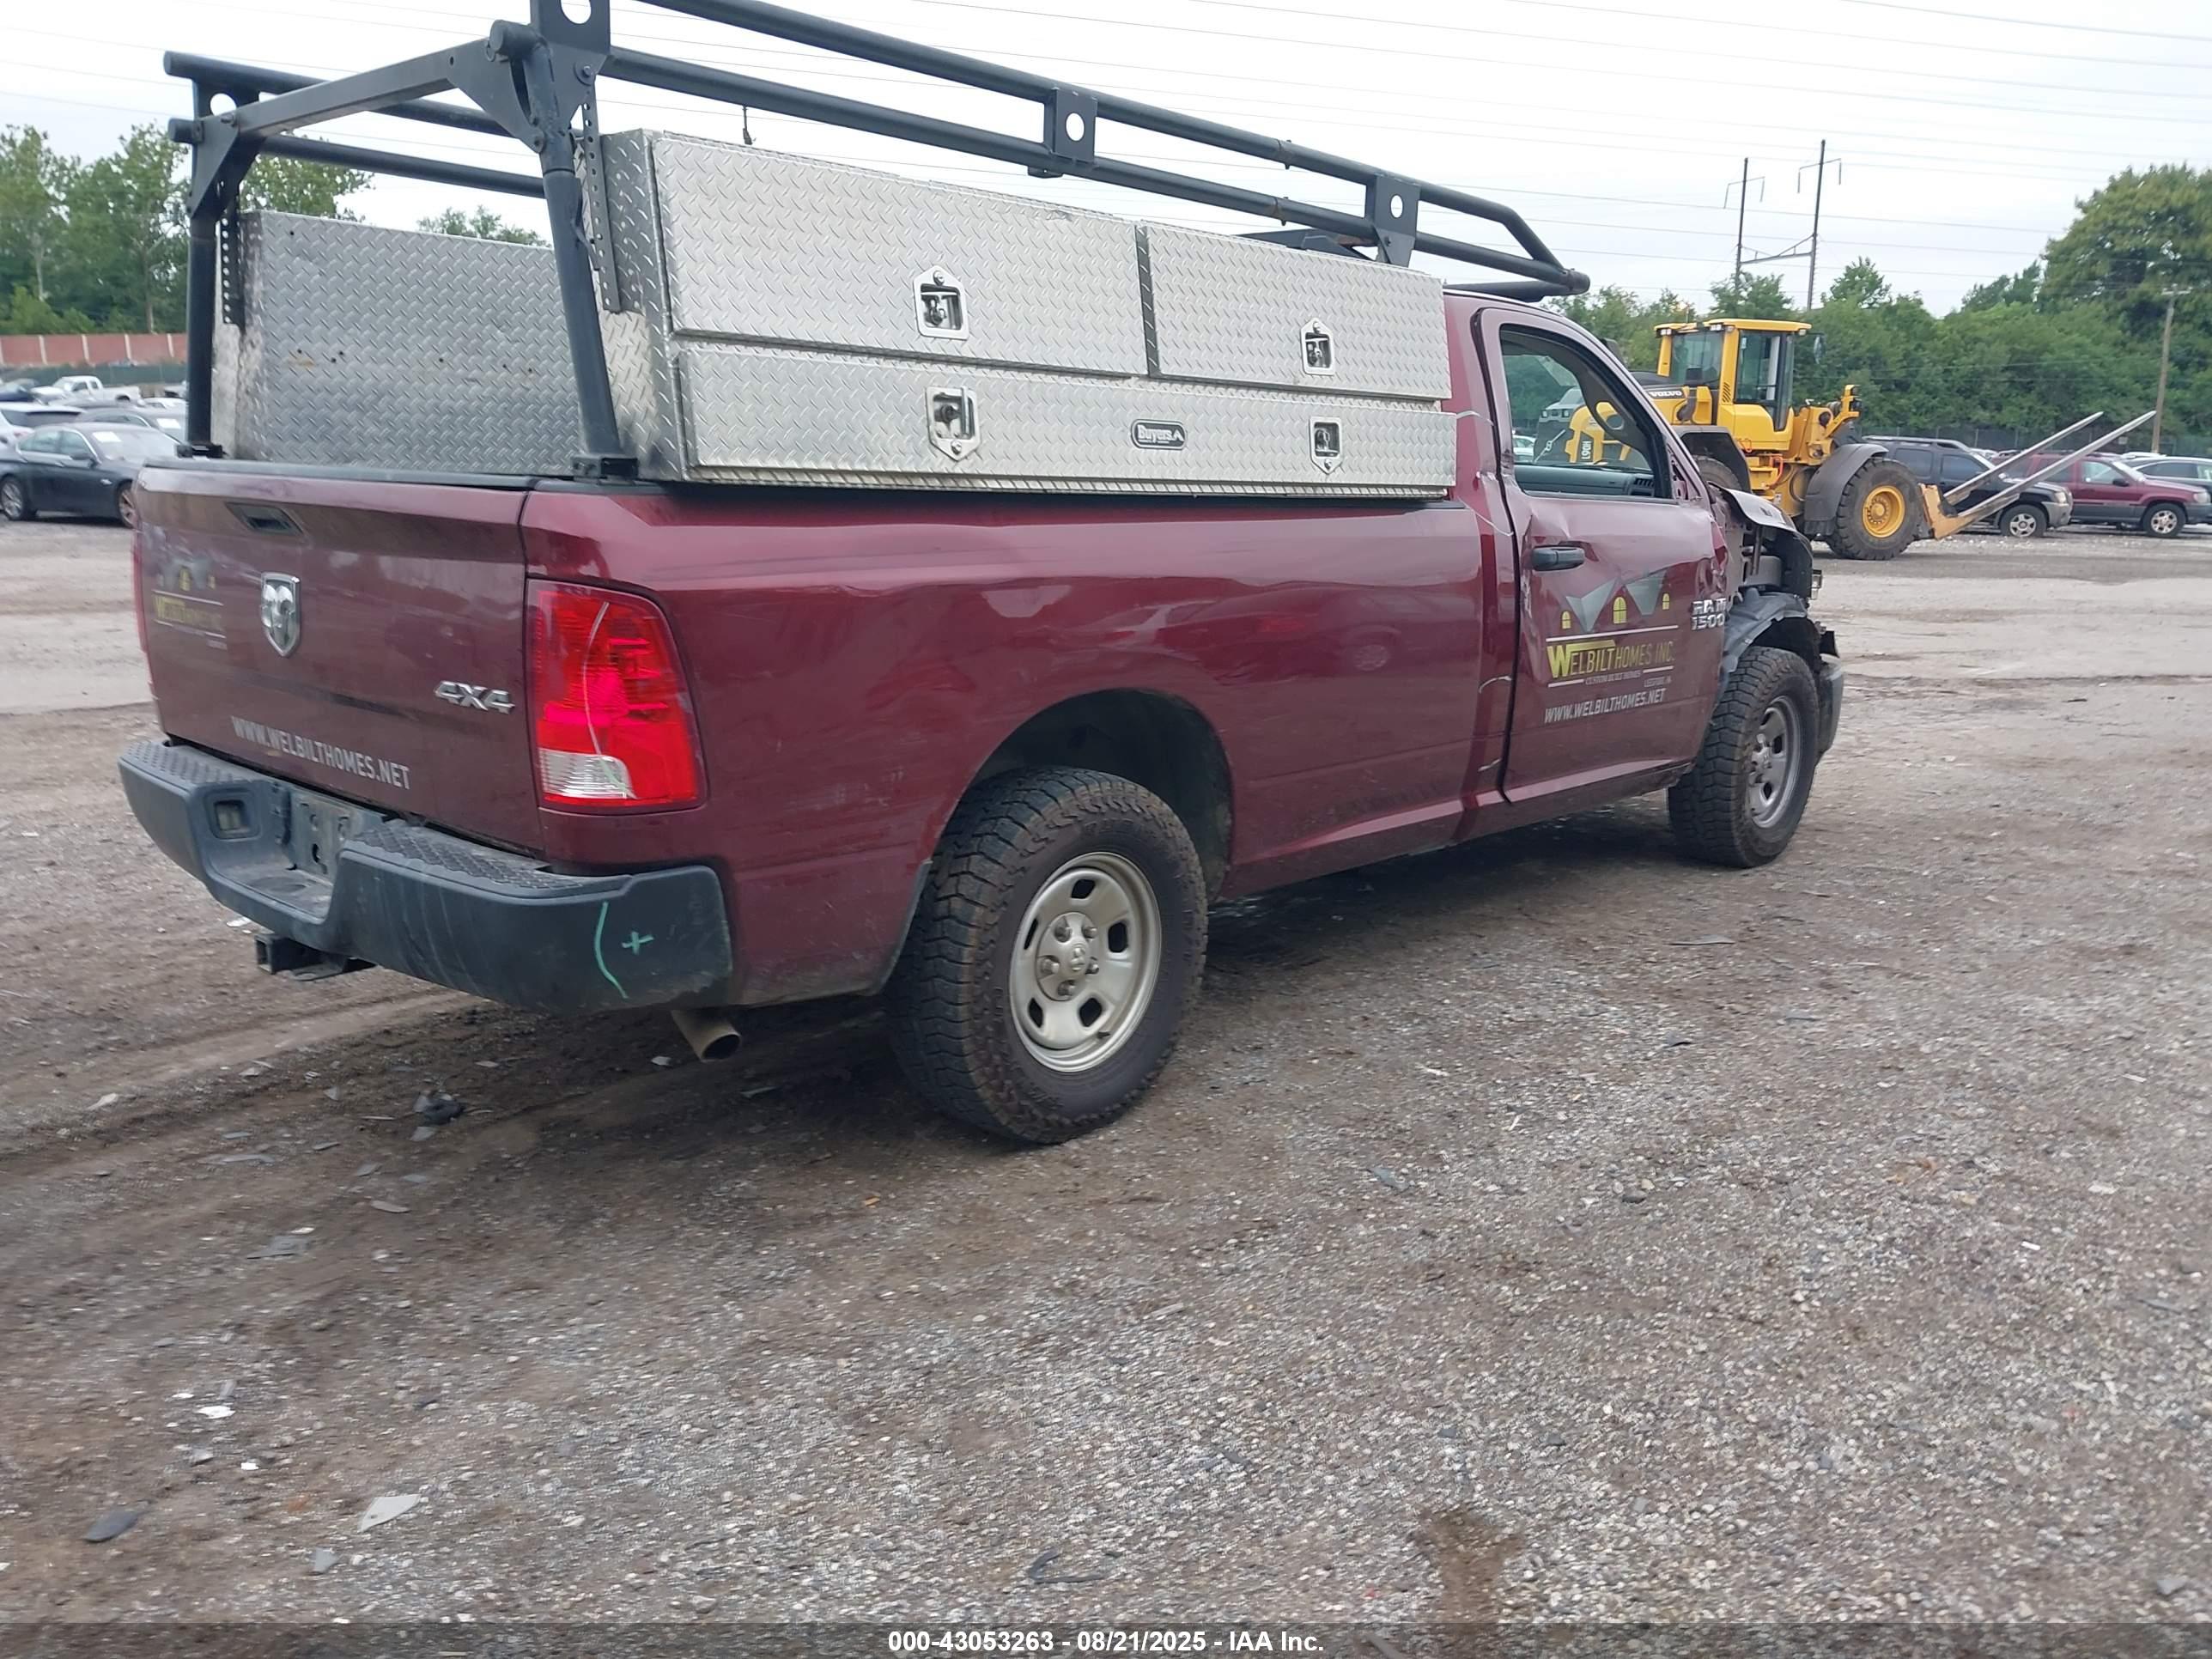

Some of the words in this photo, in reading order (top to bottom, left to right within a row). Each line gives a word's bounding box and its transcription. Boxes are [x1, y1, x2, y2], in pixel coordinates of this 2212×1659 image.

[1692, 598, 1728, 616] RAM
[1690, 613, 1726, 631] 1500
[1544, 688, 1667, 724] WWW.WELBILTHOMES.NET
[230, 716, 411, 790] WWW.WELBILTHOMES.NET
